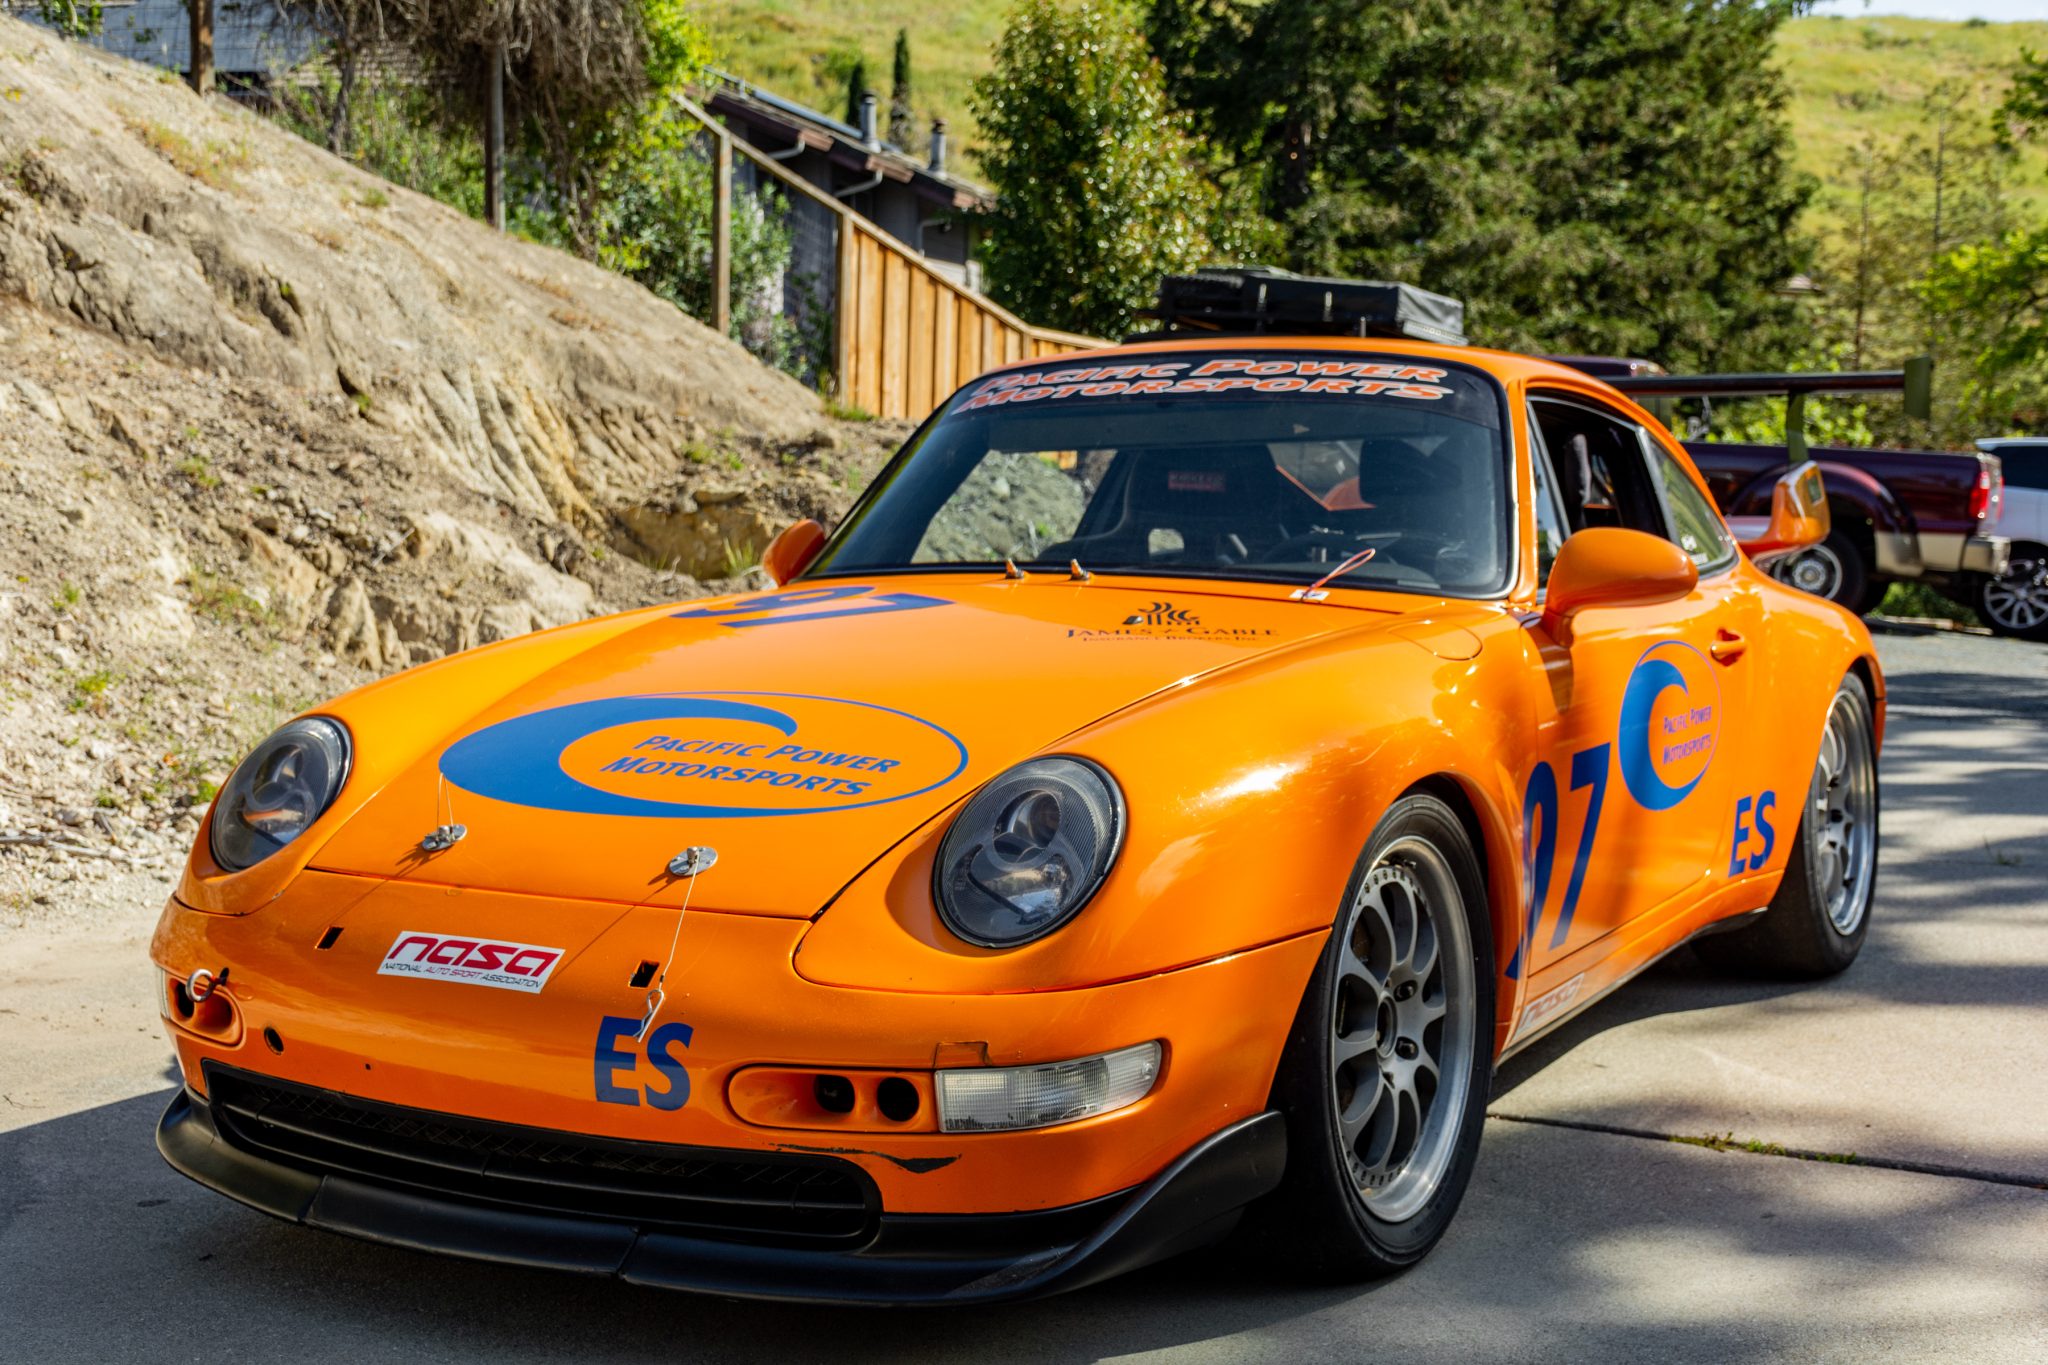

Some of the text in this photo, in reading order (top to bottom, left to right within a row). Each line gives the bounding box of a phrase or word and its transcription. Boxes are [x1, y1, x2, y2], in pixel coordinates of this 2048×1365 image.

[951, 377, 1455, 416] MOTORSPORTS
[970, 359, 1448, 396] PACIFIC POWER
[632, 735, 901, 773] PACIFIC POWER
[600, 756, 873, 796] MOTORSPORTS
[1728, 790, 1777, 879] ES
[383, 962, 542, 988] NATIONAL AUTO SPORT ASSOCIATION
[594, 1015, 694, 1112] ES
